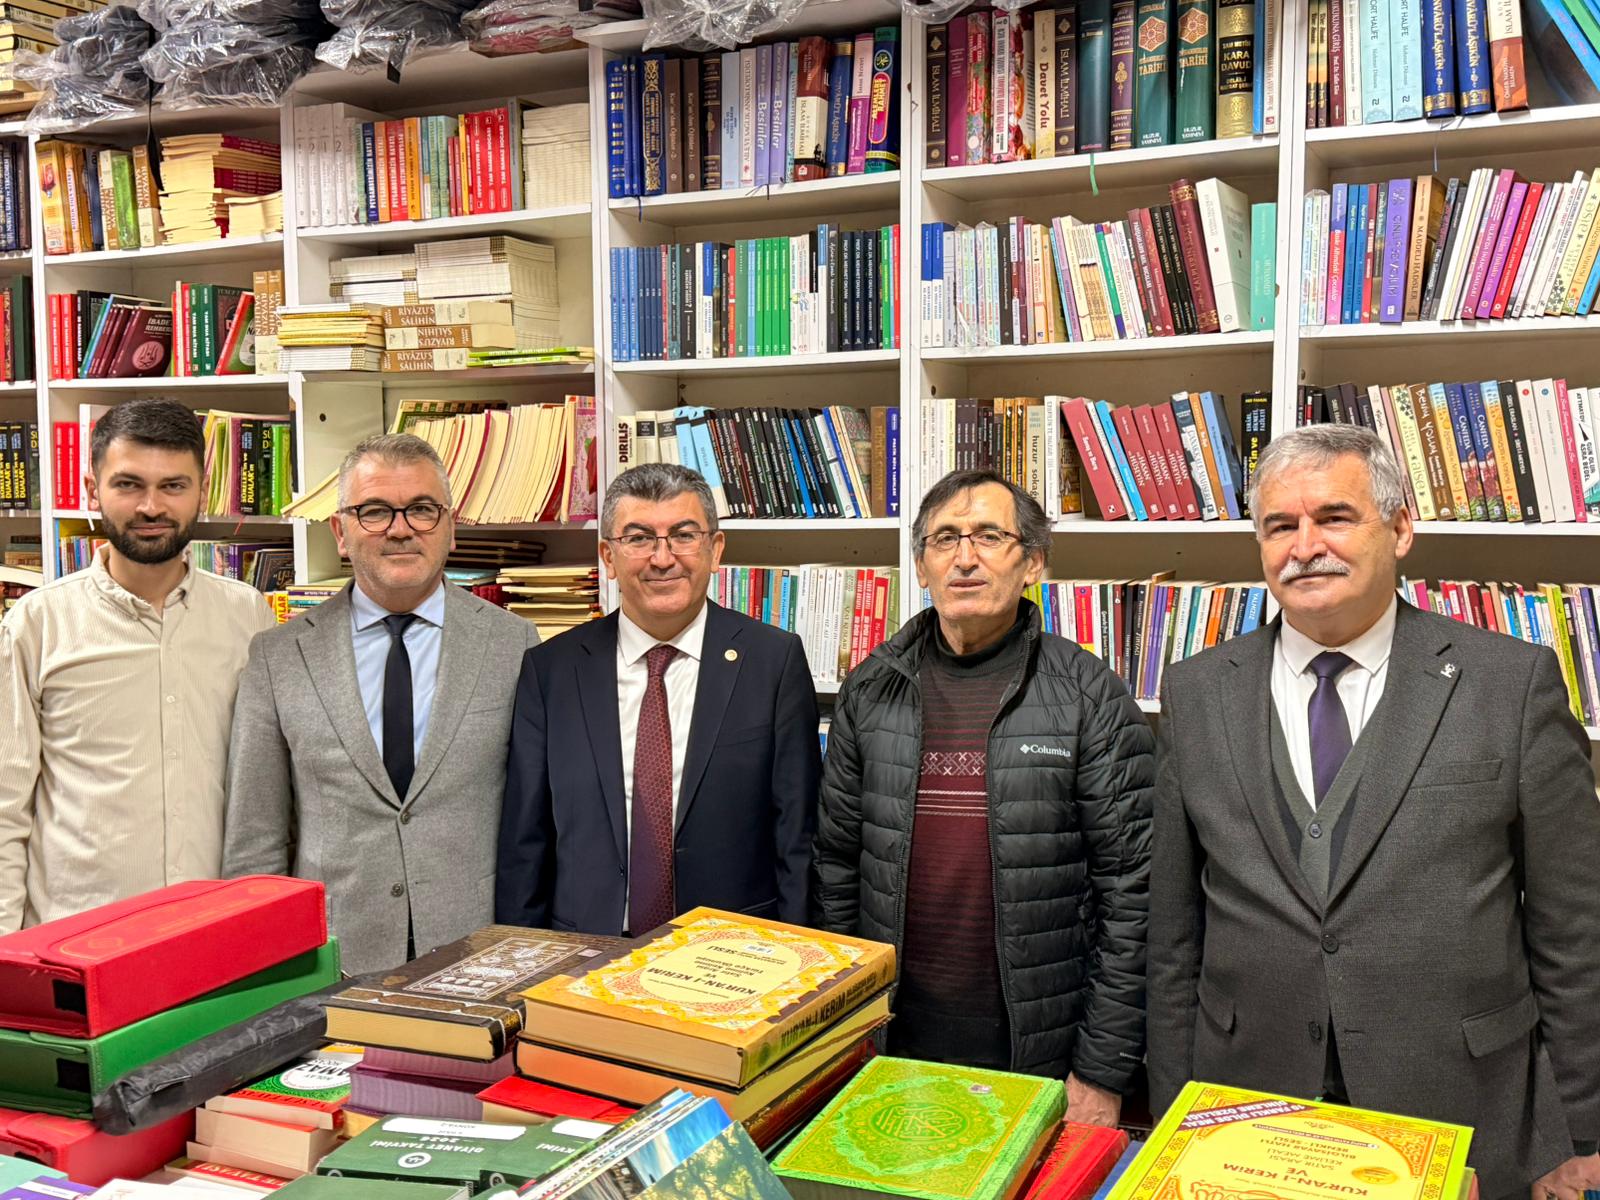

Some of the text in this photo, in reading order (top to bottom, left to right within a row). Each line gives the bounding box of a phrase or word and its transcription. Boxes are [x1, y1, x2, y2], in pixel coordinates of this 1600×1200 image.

[1504, 10, 1513, 34] İSLAM
[1331, 34, 1341, 53] GİRİŞ
[1179, 54, 1208, 67] TARİHİ
[1221, 60, 1251, 71] DAVUD
[1223, 52, 1250, 61] KARA
[1138, 61, 1168, 76] TARİHİ
[1039, 62, 1050, 129] Davet Yolu
[758, 102, 767, 150] Besinler
[772, 100, 783, 149] Besinler
[1478, 251, 1489, 272] İNANÇ
[1250, 437, 1258, 449] ve
[1459, 415, 1471, 450] CANFEDA
[1477, 414, 1489, 449] CANFEDA
[1129, 455, 1145, 487] HÜSEYİN
[1138, 456, 1151, 481] HASAN
[1149, 454, 1164, 486] HÜSEYİN
[1159, 455, 1170, 480] HASAN
[1168, 453, 1182, 486] HÜSEYİN
[1177, 455, 1188, 480] HASAN
[1580, 443, 1591, 482] ASRA BEDEL
[1588, 457, 1596, 474] OLUR
[1030, 744, 1071, 757] Columbia
[707, 945, 738, 956] SESLİ
[647, 967, 757, 996] KUR'AN-I KERİM
[820, 991, 847, 1022] KERİM
[1181, 1106, 1289, 1129] FARKLI DİLDE MEAL
[1184, 1100, 1288, 1121] DİNLEME ÖZELLİĞİ
[369, 1140, 485, 1154] DİYANET TAKVİMİ
[1267, 1148, 1344, 1166] KELİME MEALİ
[1294, 1145, 1357, 1159] BİLGİSAYAR
[1269, 1155, 1335, 1171] SATIR ARASI
[1286, 1167, 1309, 1177] VE
[1223, 1163, 1369, 1197] KUR'AN-I KERİM
